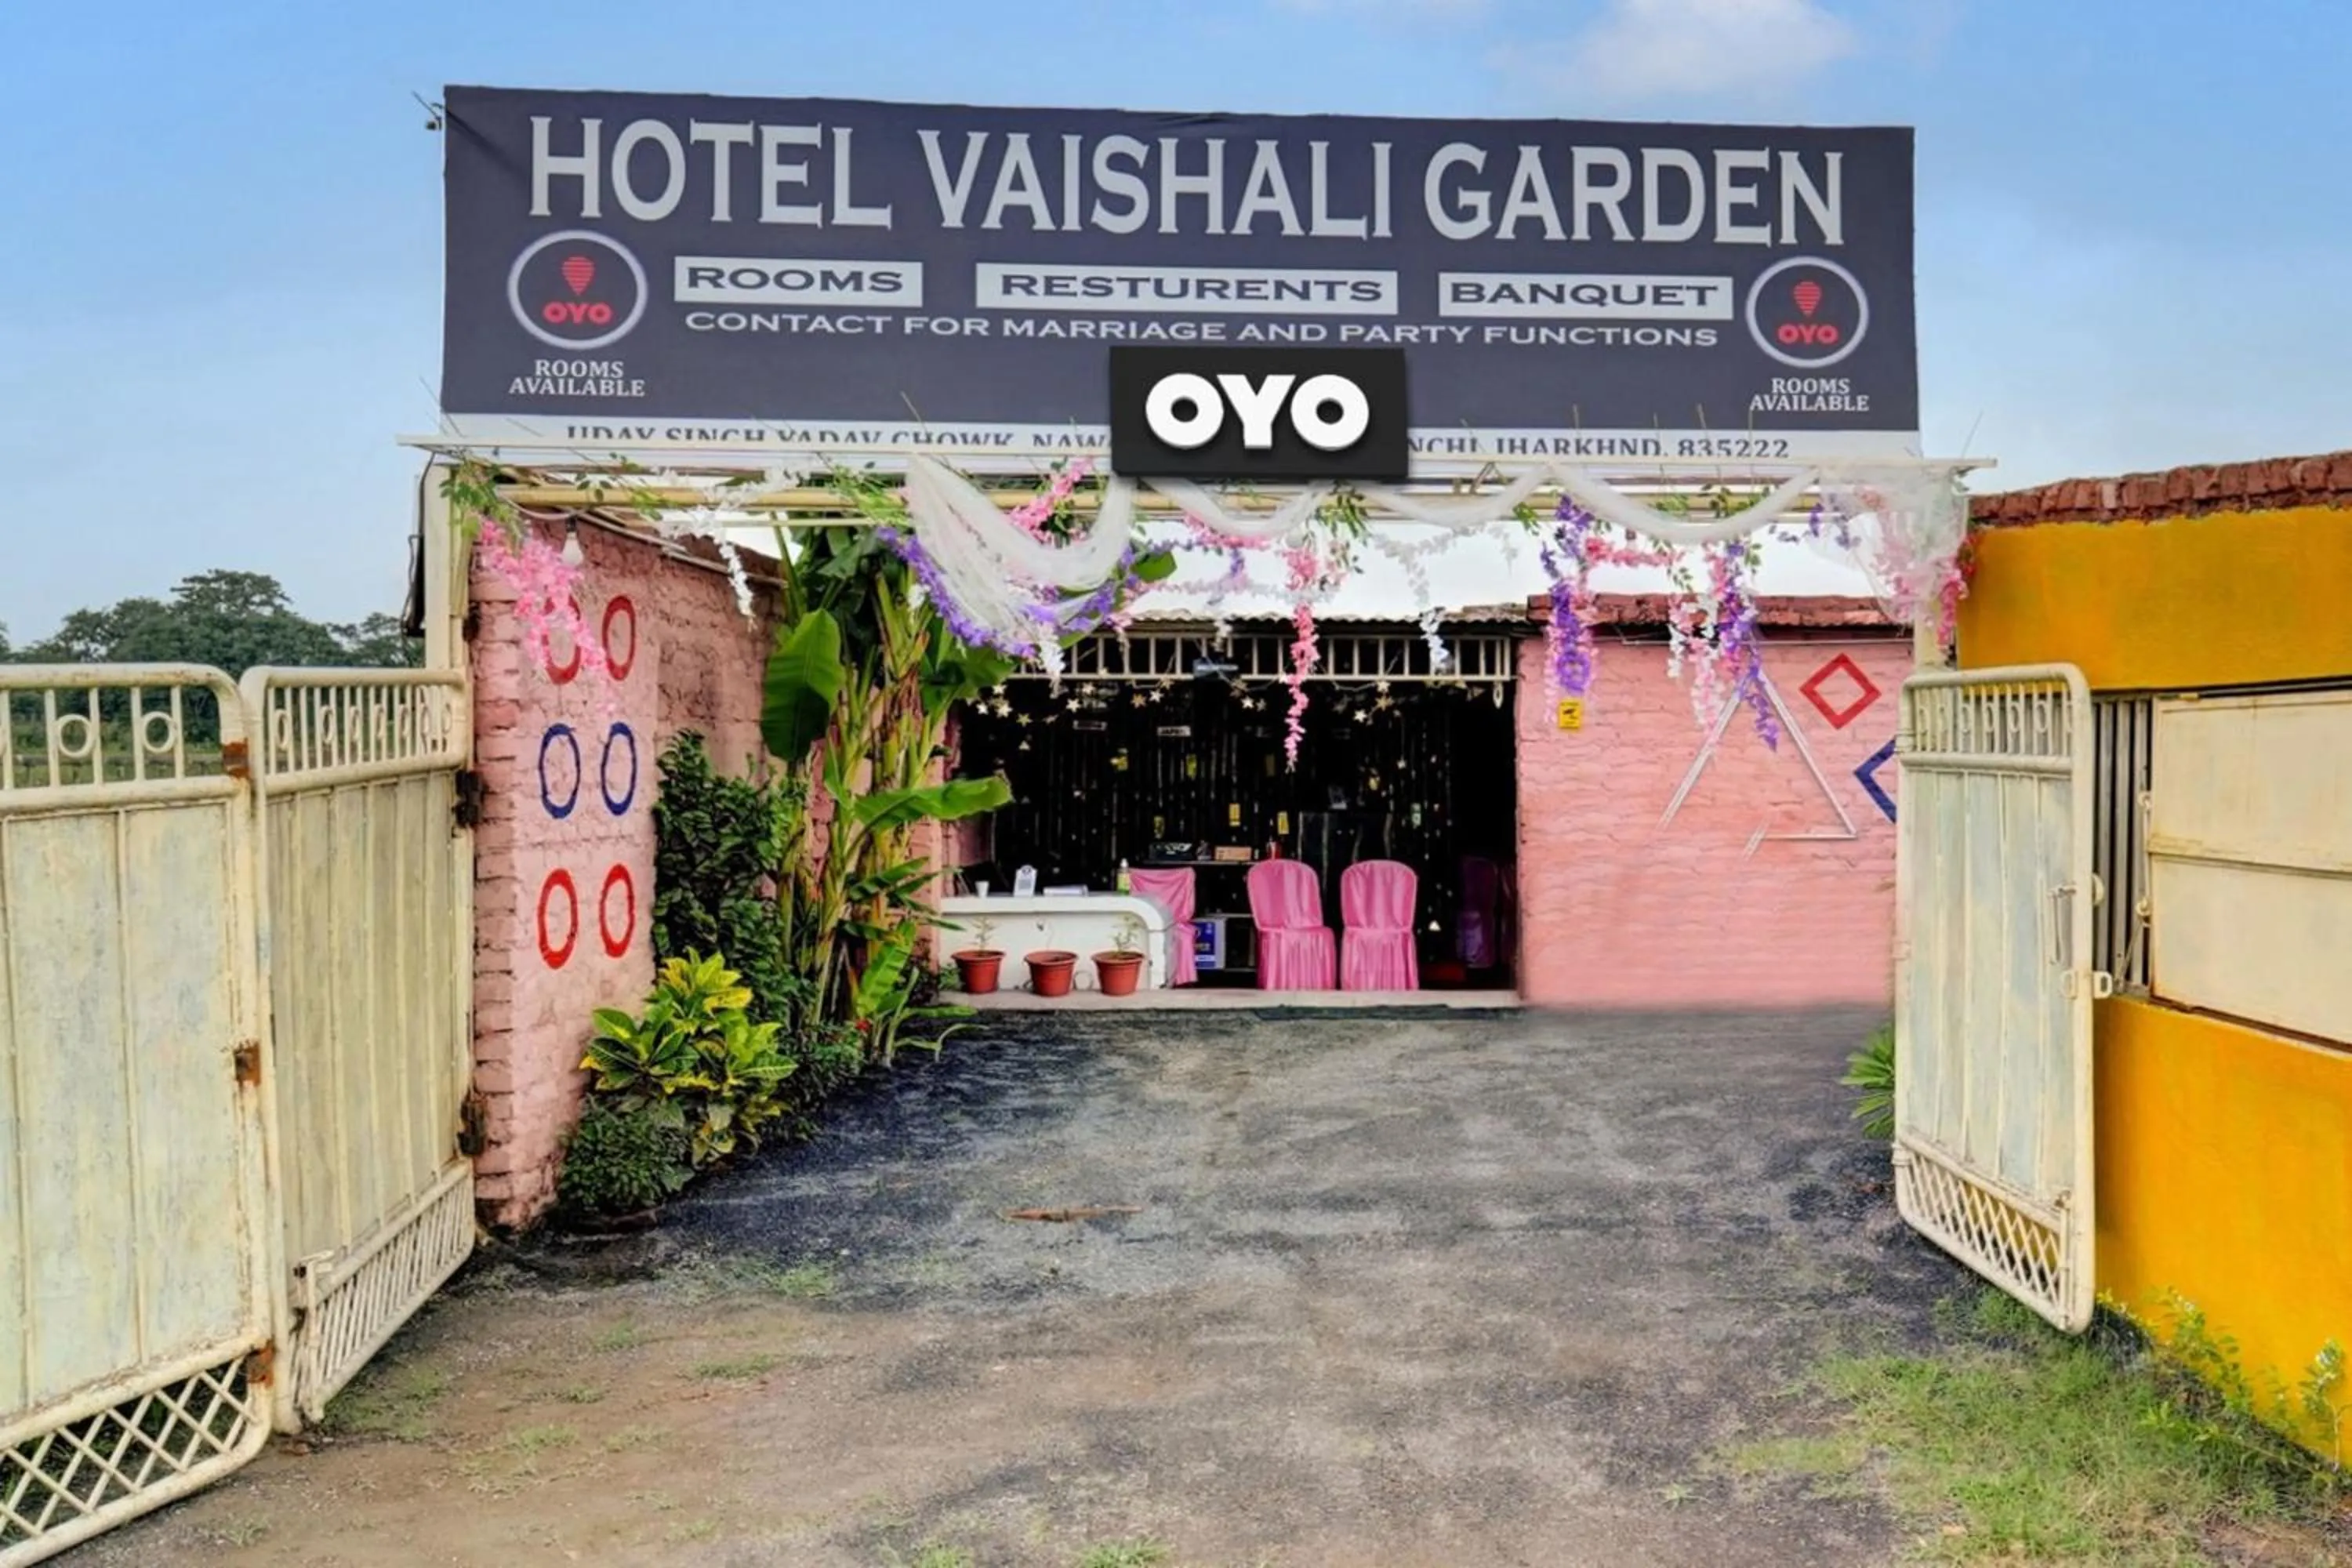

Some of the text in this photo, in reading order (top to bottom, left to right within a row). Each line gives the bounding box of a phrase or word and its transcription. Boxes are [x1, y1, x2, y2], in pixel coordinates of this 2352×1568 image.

[531, 115, 1844, 248] HOTEL VAISHALI GARDEN
[688, 267, 903, 293] ROOMS
[1001, 274, 1382, 302] RESTURENTS
[1451, 281, 1719, 307] BANQUET
[543, 301, 614, 325] OYO
[685, 311, 1718, 347] CONTACT FOR MARRIAGE AND PARTY FUNCTIONS
[1777, 323, 1839, 345] OYO
[535, 359, 624, 378] ROOMS
[509, 376, 646, 397] AVAILABLE
[1771, 377, 1851, 394] ROOMS
[1145, 372, 1370, 450] OYO
[1749, 393, 1871, 412] AVAILABLE
[1678, 438, 1790, 459] 835222
